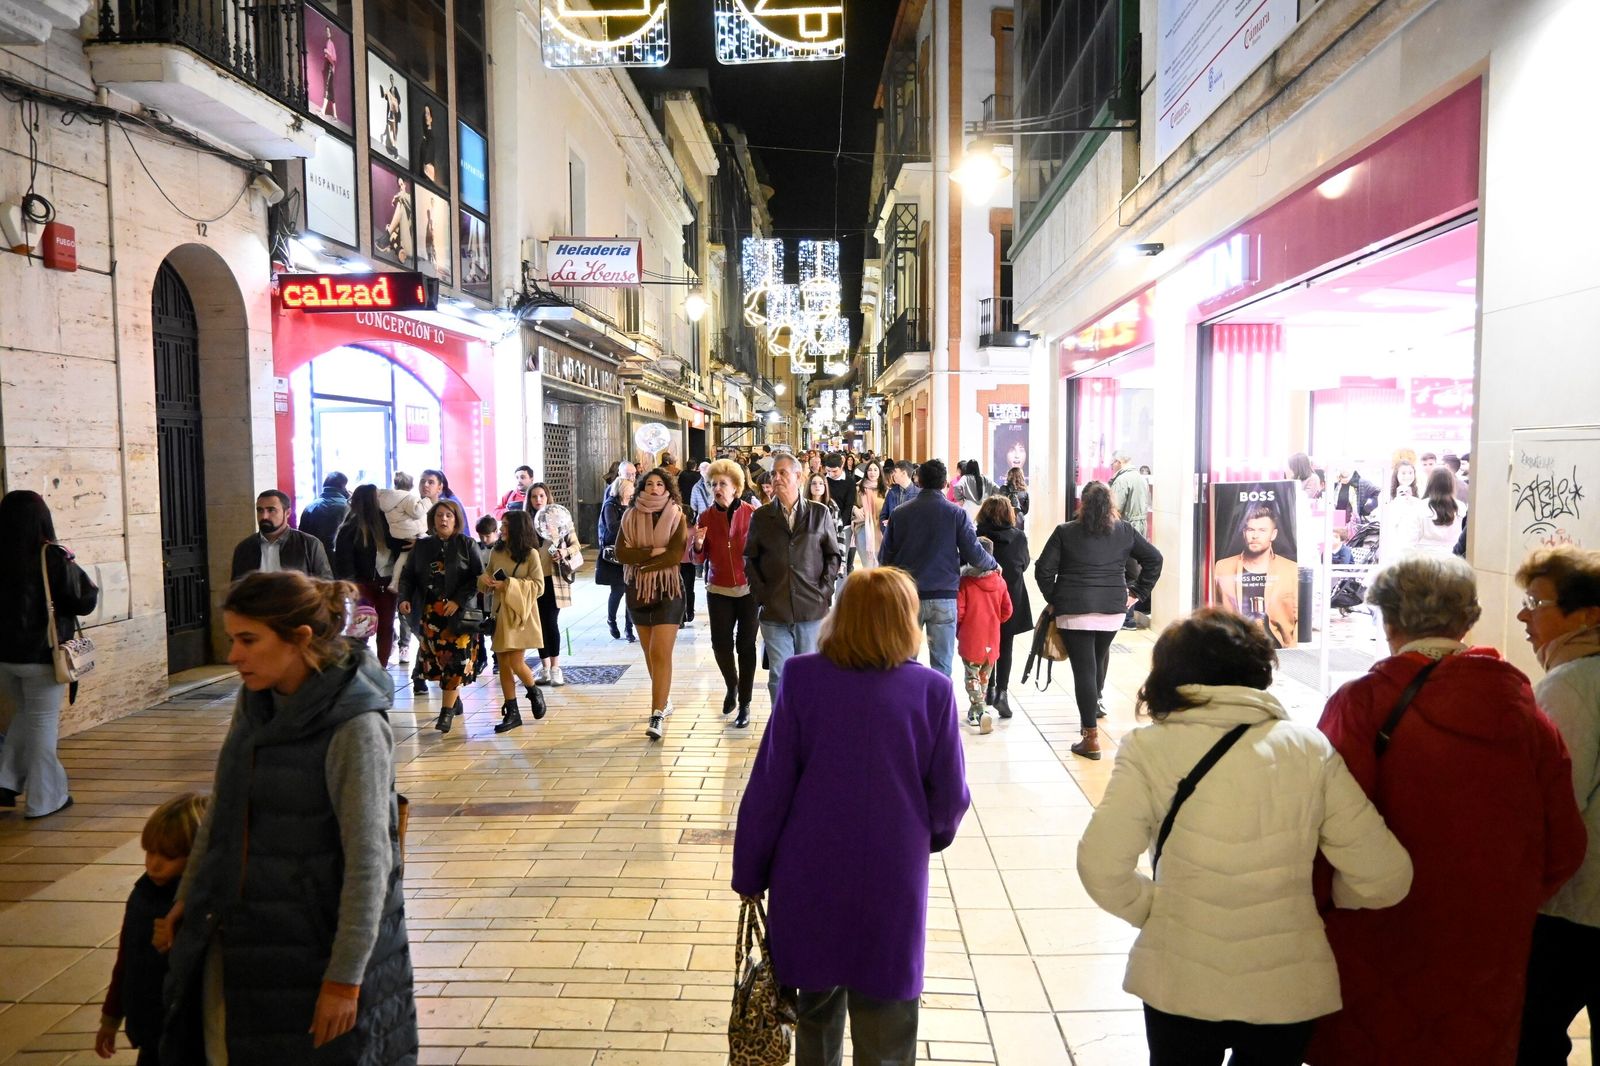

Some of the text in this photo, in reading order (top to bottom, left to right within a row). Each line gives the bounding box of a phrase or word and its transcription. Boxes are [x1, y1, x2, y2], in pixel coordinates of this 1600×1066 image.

[310, 172, 350, 199] HISPANITAS
[196, 223, 208, 237] 12
[56, 237, 76, 248] FUEGO
[551, 259, 577, 281] La
[356, 312, 445, 344] CONCEPCIÓN 10
[1239, 490, 1275, 502] BOSS
